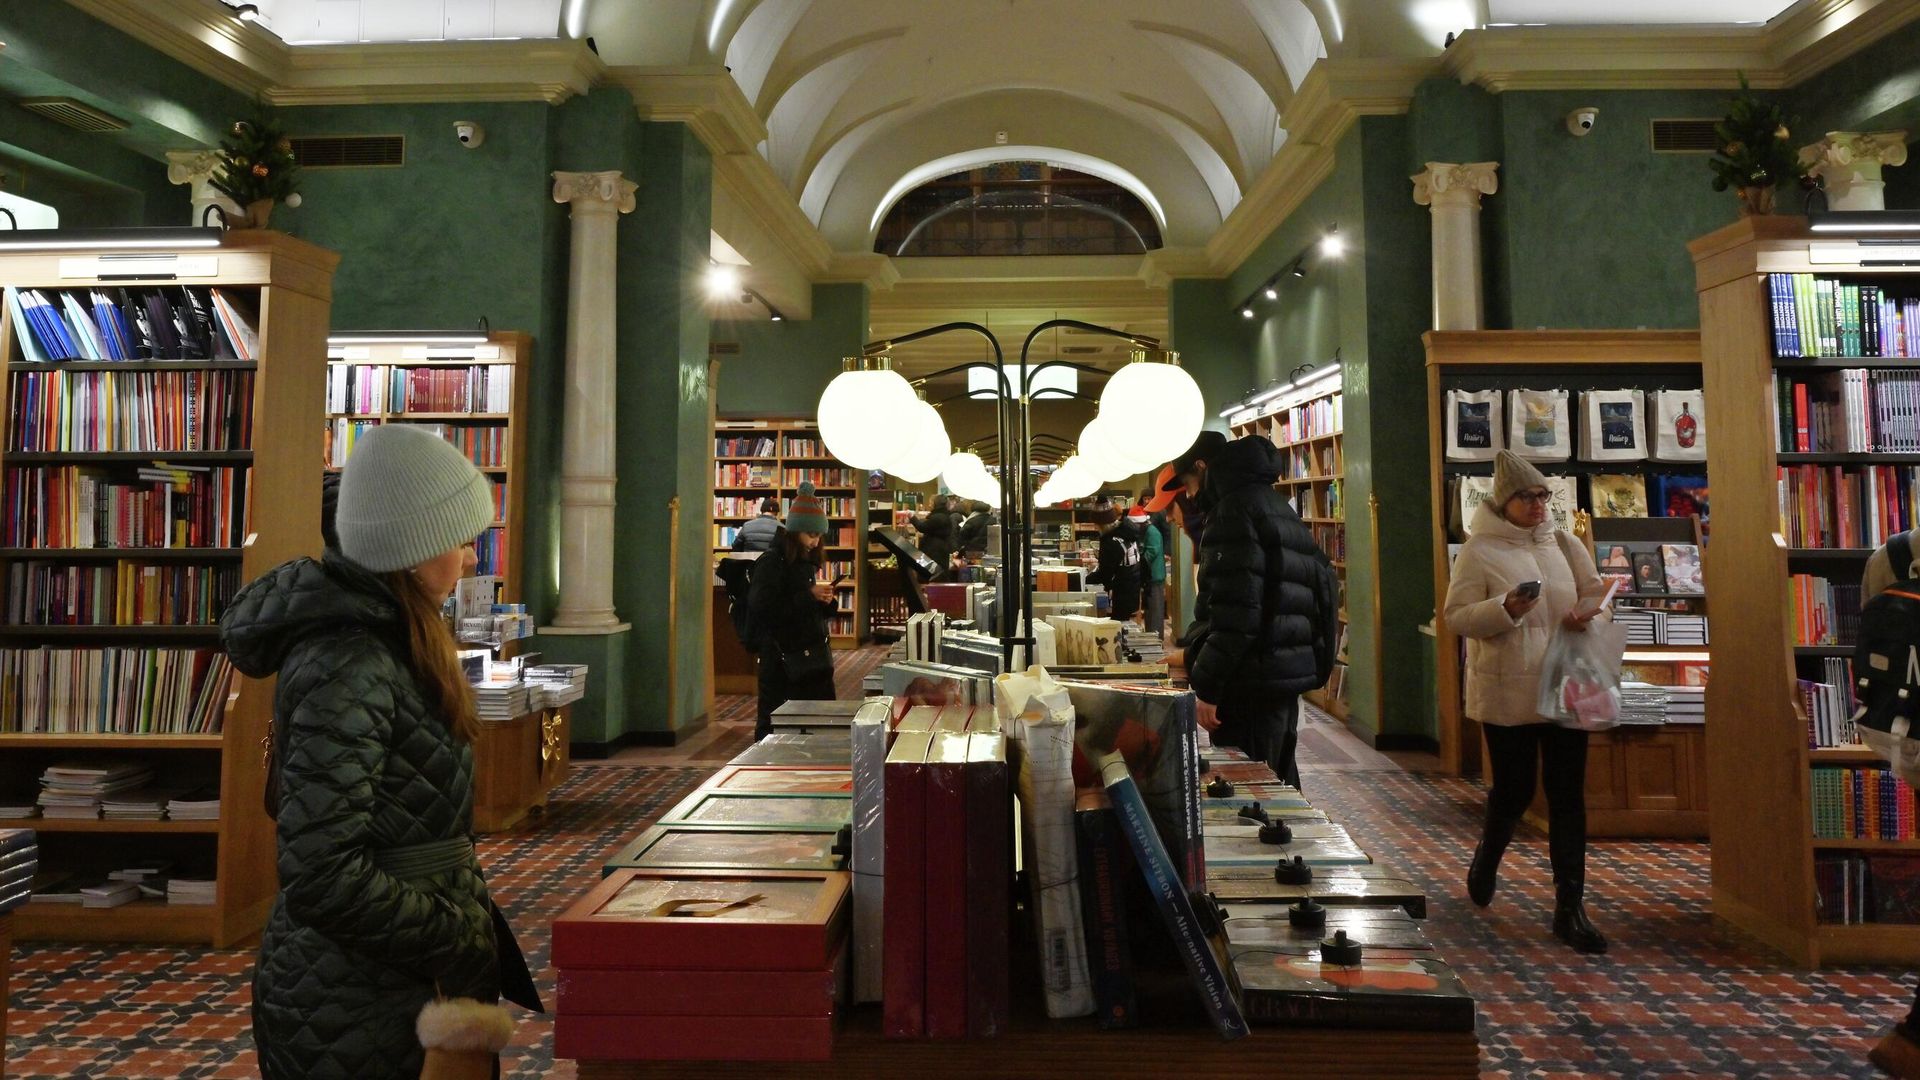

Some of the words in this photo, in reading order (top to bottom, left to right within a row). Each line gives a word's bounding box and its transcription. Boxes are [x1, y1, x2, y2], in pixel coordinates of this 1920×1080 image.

[1124, 802, 1151, 855] MARTINE
[1149, 855, 1175, 899] SITBON
[1176, 914, 1206, 974] Alternative
[1201, 974, 1223, 1009] Vision
